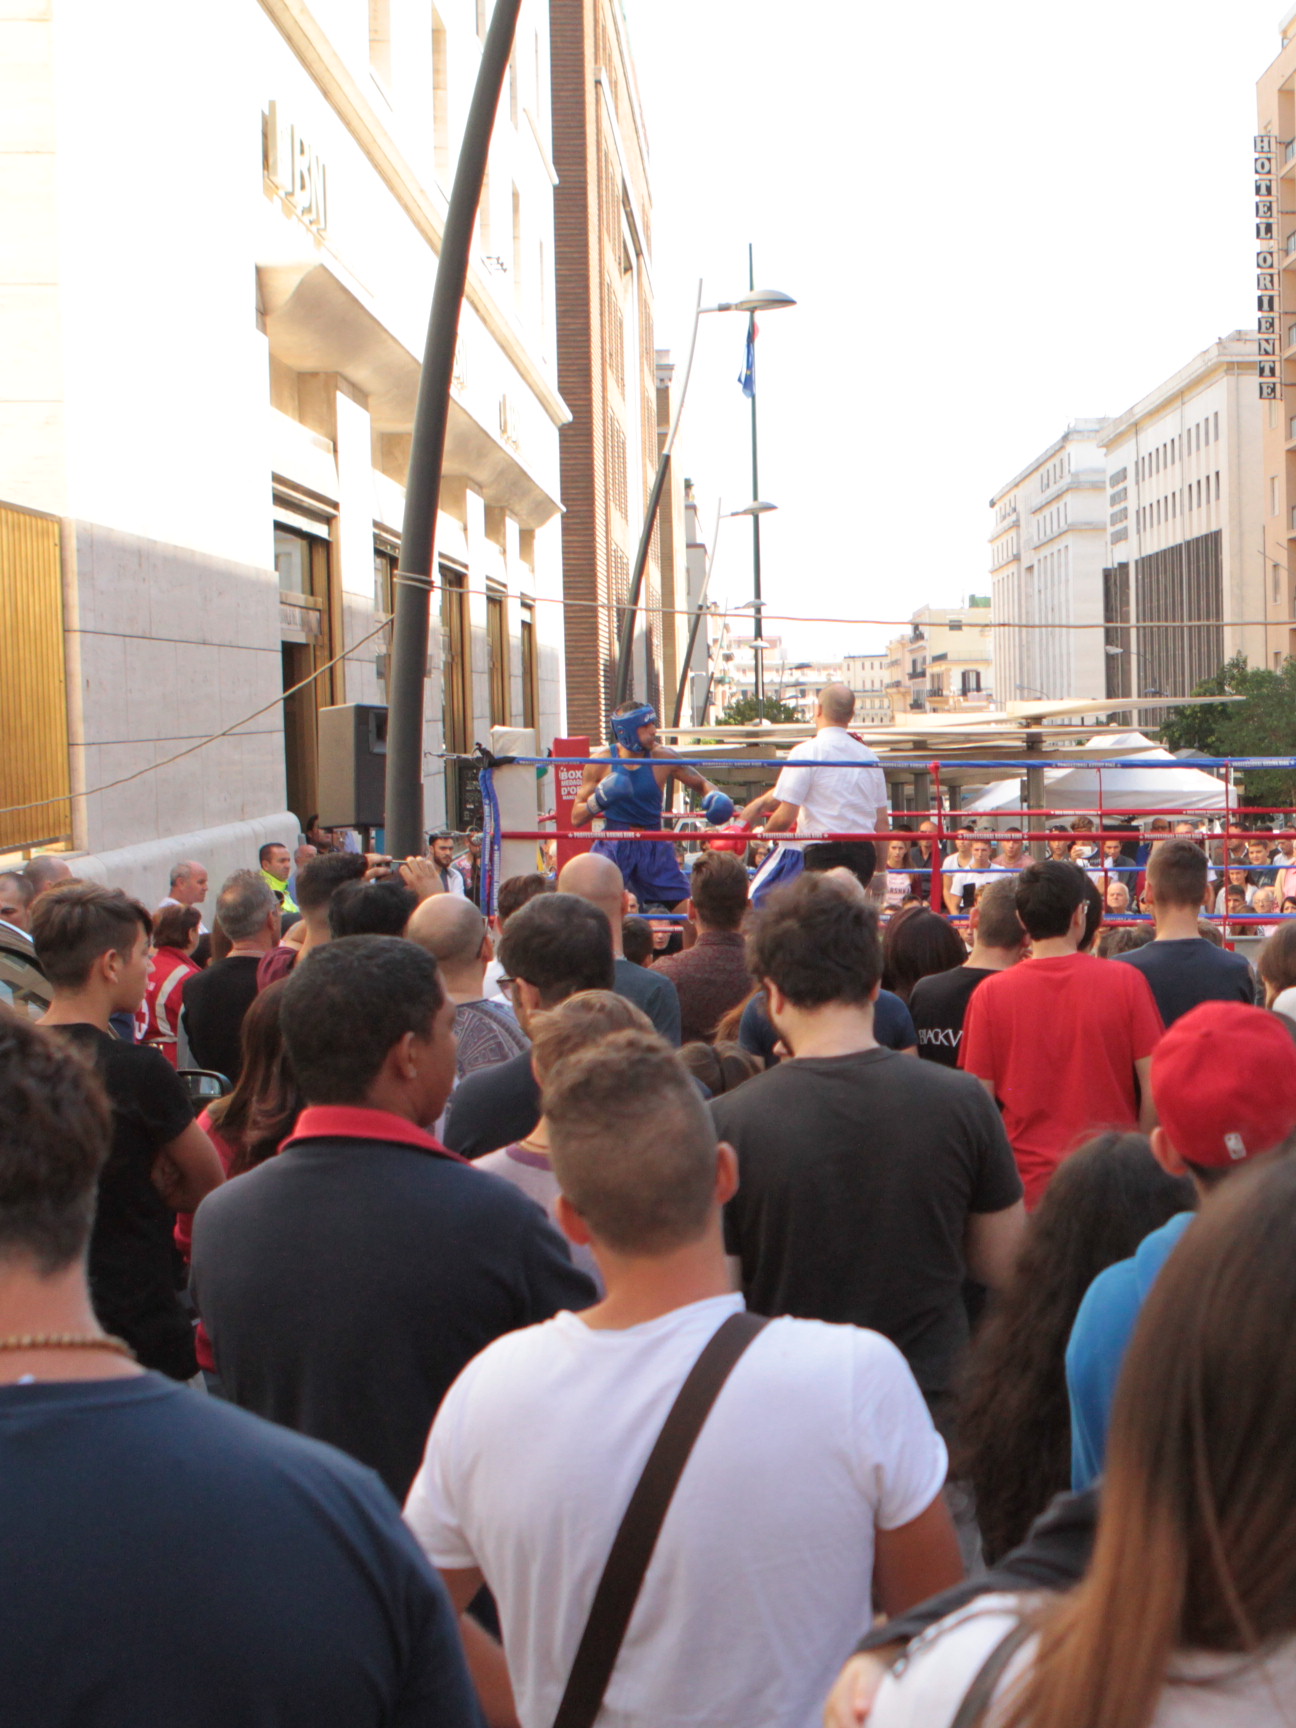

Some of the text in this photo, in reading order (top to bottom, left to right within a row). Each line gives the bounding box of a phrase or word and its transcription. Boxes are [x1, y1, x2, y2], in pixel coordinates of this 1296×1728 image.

[1255, 136, 1273, 240] HOTEL
[1257, 252, 1277, 400] ORIENTE
[561, 770, 583, 780] BOX
